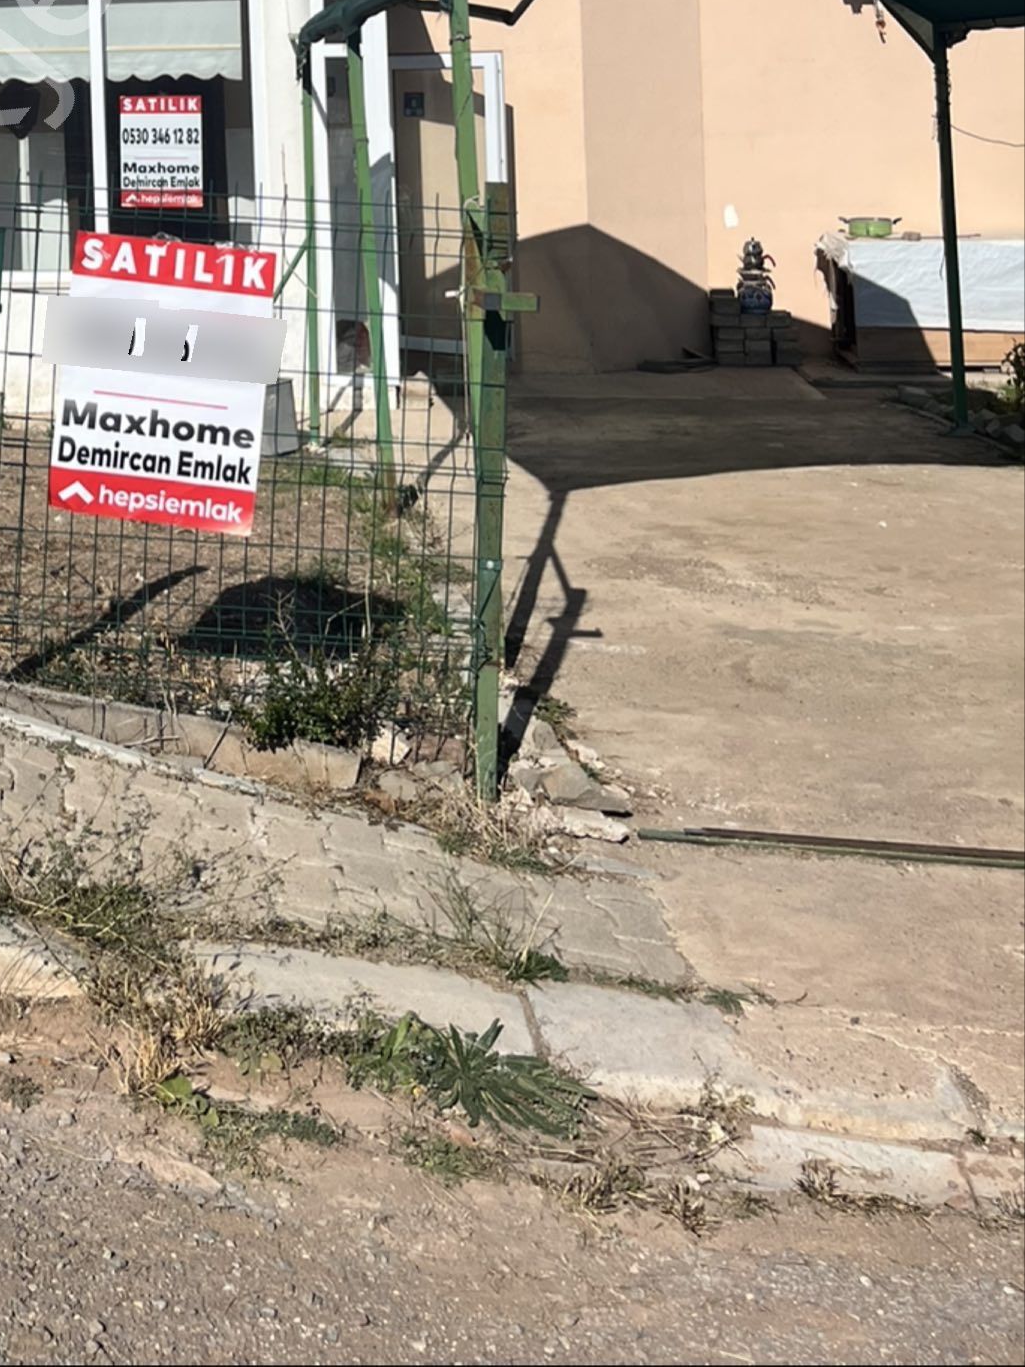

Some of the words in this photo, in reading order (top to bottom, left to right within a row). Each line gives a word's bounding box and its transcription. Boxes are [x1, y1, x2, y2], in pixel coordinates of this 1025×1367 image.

[123, 98, 198, 111] SATILIK
[122, 128, 149, 144] 0530
[151, 128, 171, 144] 346
[174, 128, 184, 144] 12
[186, 128, 200, 144] 82
[123, 162, 200, 174] Maxhome
[123, 177, 168, 187] Demircan
[170, 177, 201, 187] Emlak
[81, 238, 268, 289] SATILIK
[61, 399, 255, 449] Maxhome
[57, 435, 171, 475] Demircan
[177, 450, 252, 485] Emlak
[98, 484, 244, 524] hepsiemlak
